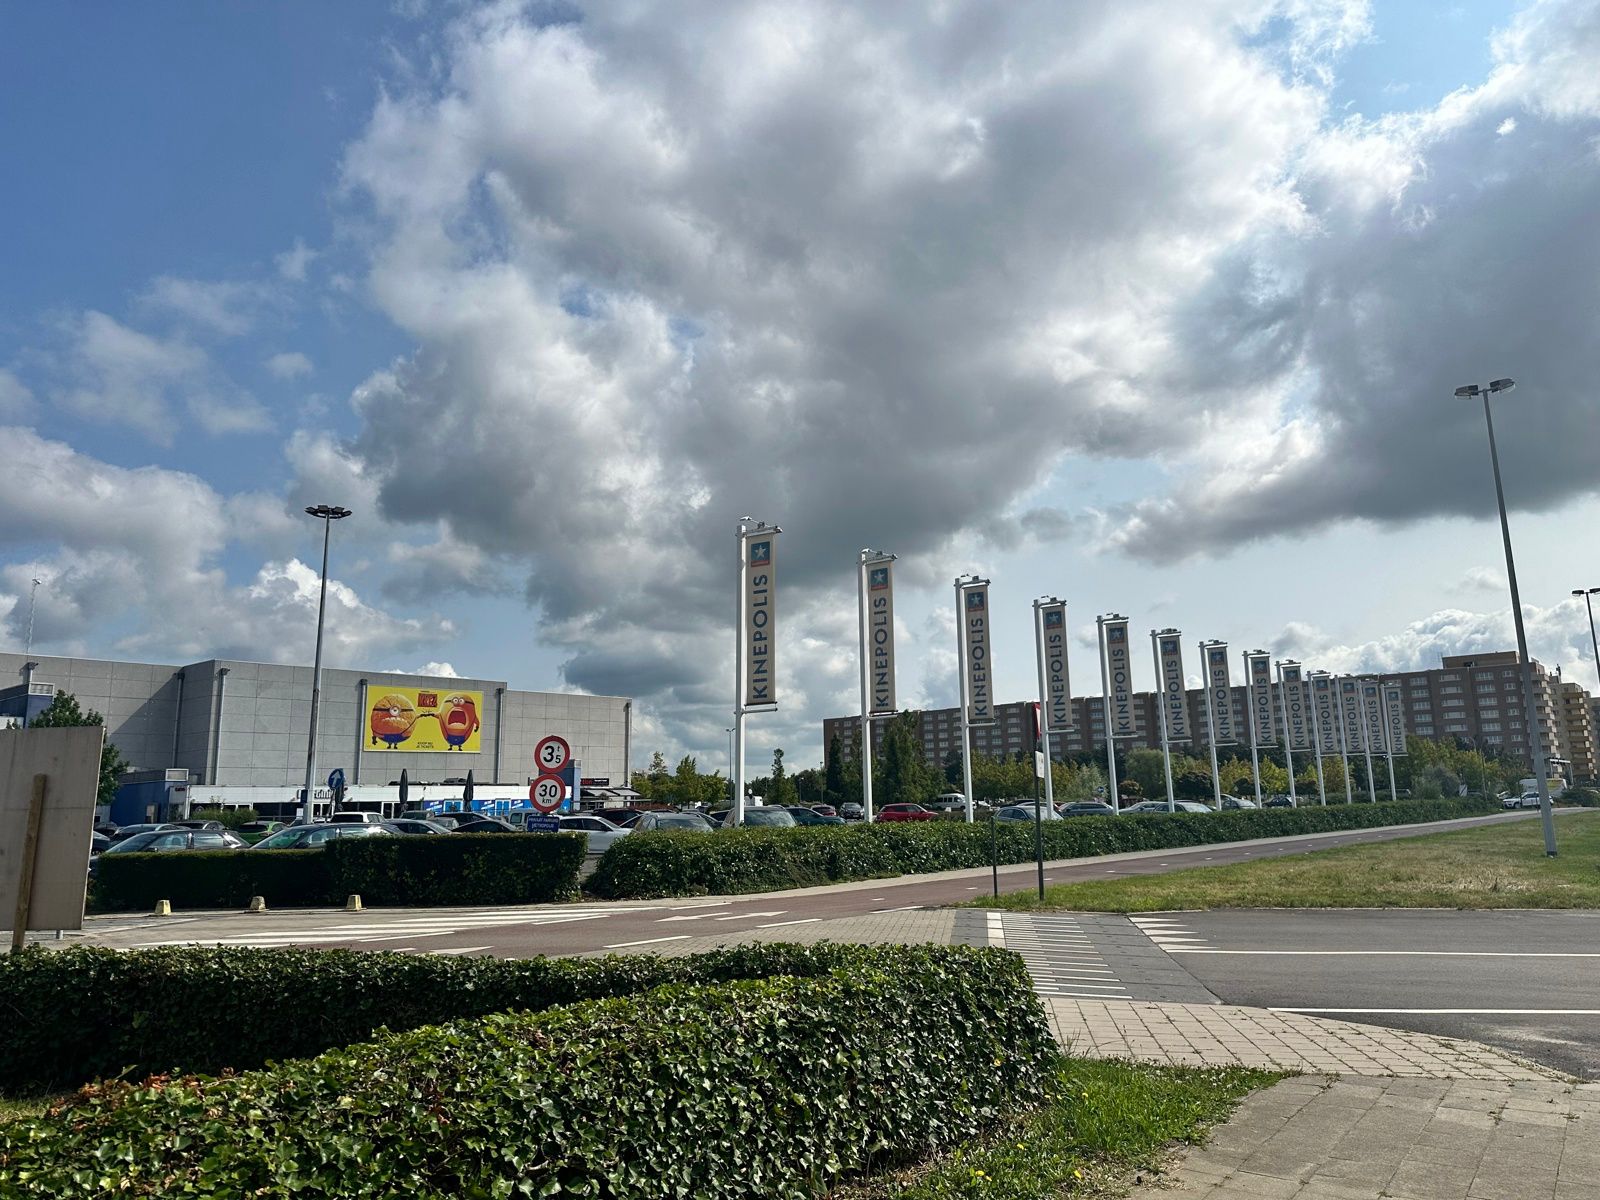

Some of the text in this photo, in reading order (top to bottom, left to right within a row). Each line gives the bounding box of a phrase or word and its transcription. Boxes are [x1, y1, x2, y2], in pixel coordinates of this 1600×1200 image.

[753, 574, 768, 699] KINEPOLIS
[874, 597, 888, 707] KINEPOLIS
[971, 617, 987, 716] KINEPOLIS
[1049, 634, 1067, 723] KINEPOLIS
[1113, 649, 1130, 731] KINEPOLIS
[1167, 660, 1184, 735] KINEPOLIS
[1214, 670, 1230, 739] KINEPOLIS
[1256, 678, 1272, 743] KINEPOLIS
[1289, 686, 1305, 746] KINEPOLIS
[1319, 694, 1334, 751] KINEPOLIS
[1346, 696, 1360, 750] KINEPOLIS
[1368, 700, 1382, 751] KINEPOLIS
[1390, 704, 1403, 752] KINEPOLIS
[538, 784, 557, 798] 30
